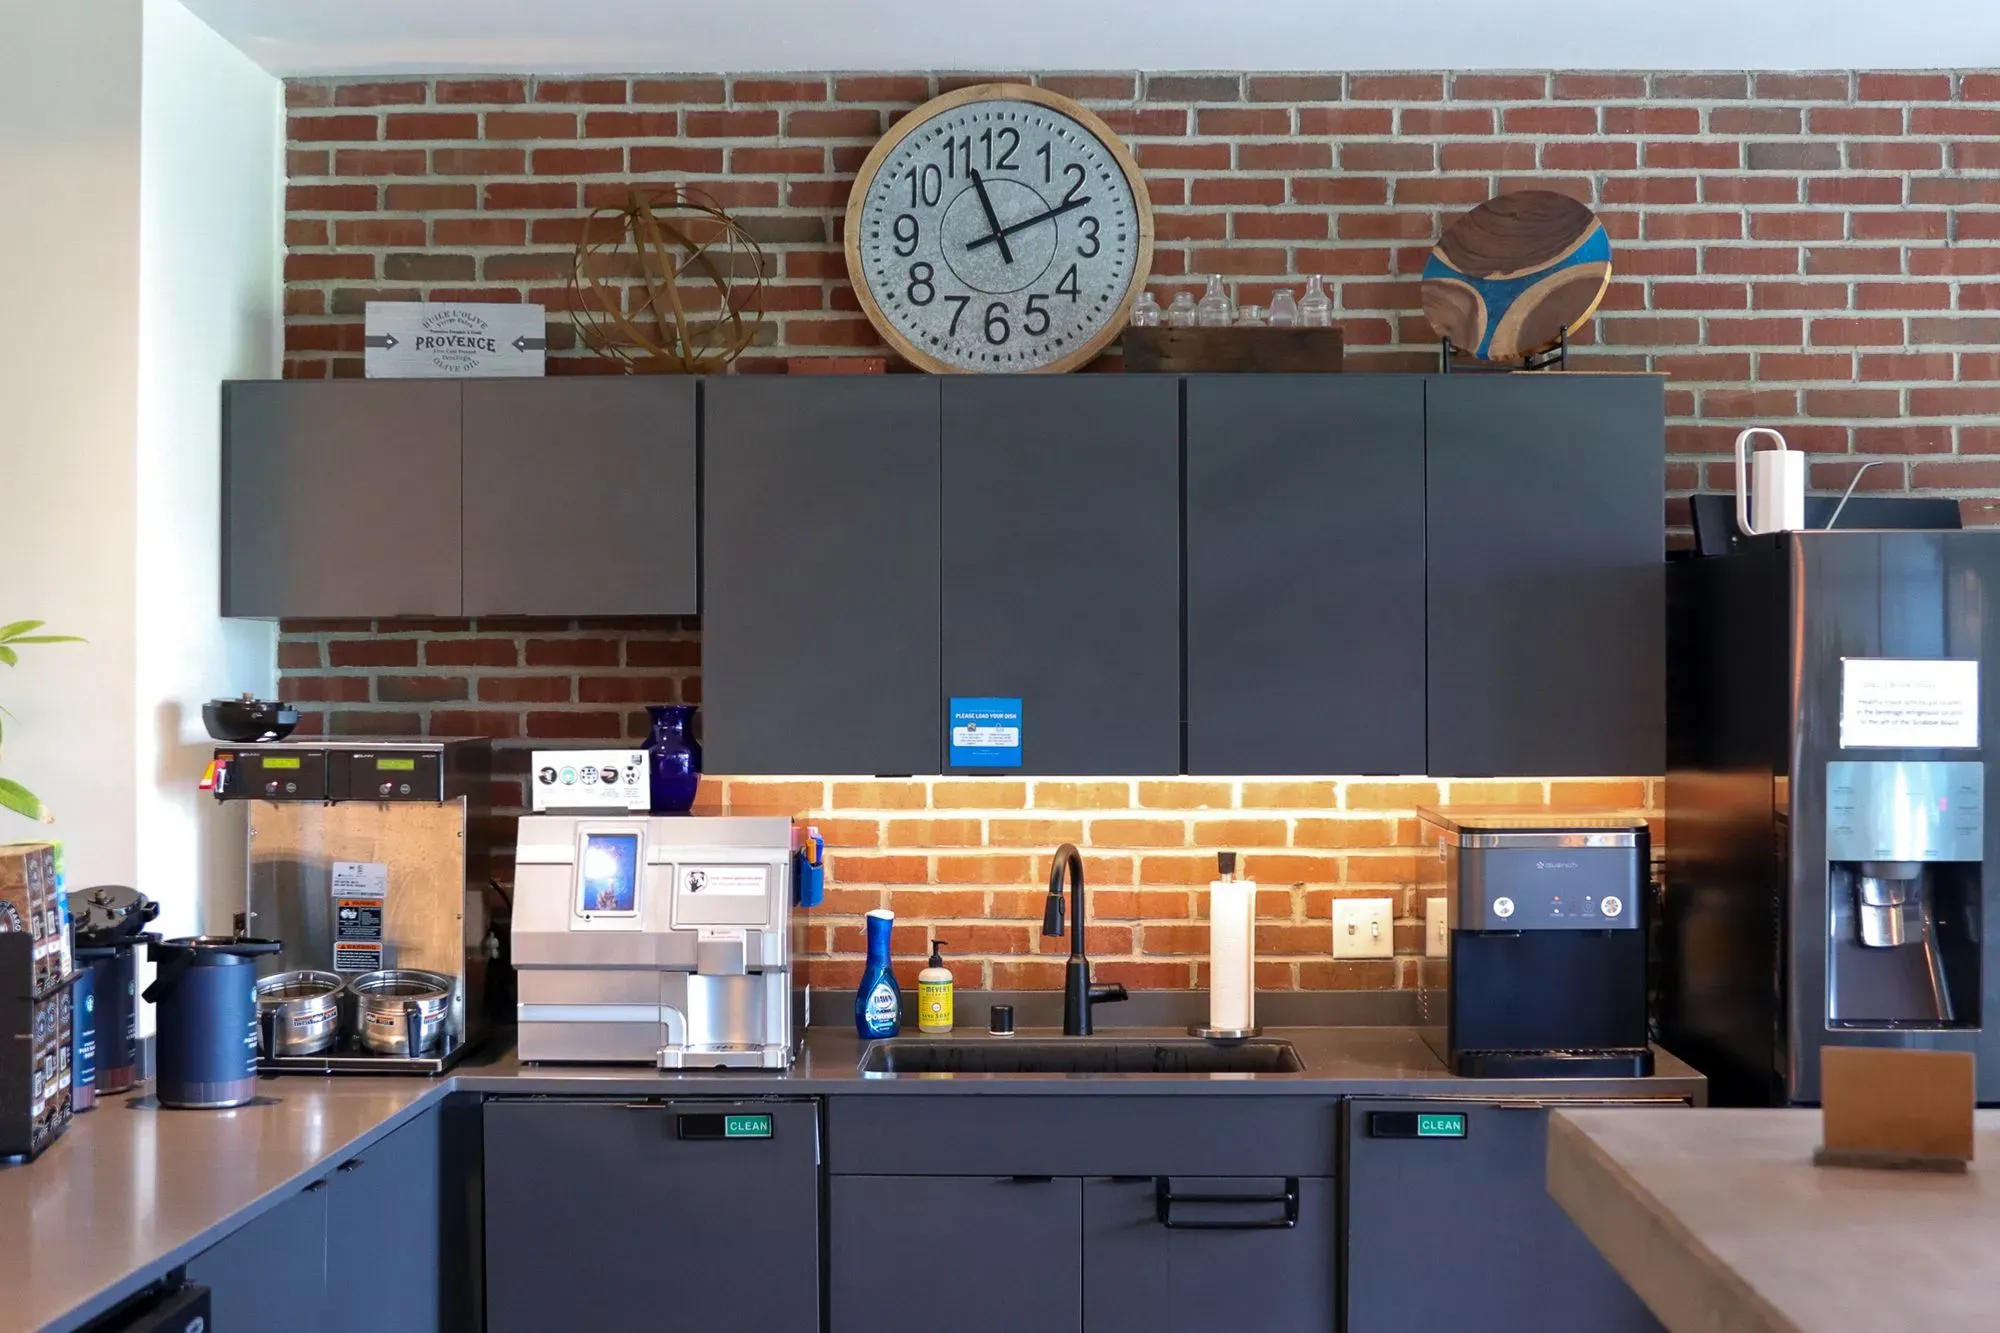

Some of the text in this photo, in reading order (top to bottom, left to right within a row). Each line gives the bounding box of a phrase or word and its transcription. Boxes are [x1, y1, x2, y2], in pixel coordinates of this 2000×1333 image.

[943, 136, 972, 179] 11
[980, 127, 1020, 170] 12
[1036, 141, 1051, 183] 1
[904, 164, 942, 208] 10
[1062, 163, 1088, 206] 2
[893, 214, 920, 257] 9
[1077, 216, 1101, 258] 3
[907, 262, 935, 306] 8
[1055, 263, 1082, 303] 4
[422, 310, 450, 329] HUILE
[944, 295, 971, 337] 7
[984, 302, 1010, 345] 6
[1023, 294, 1050, 336] 5
[415, 335, 496, 353] PROVENCE
[873, 995, 893, 1004] DAWN
[730, 1121, 768, 1131] CLEAN
[1421, 1120, 1461, 1130] CLEAN
